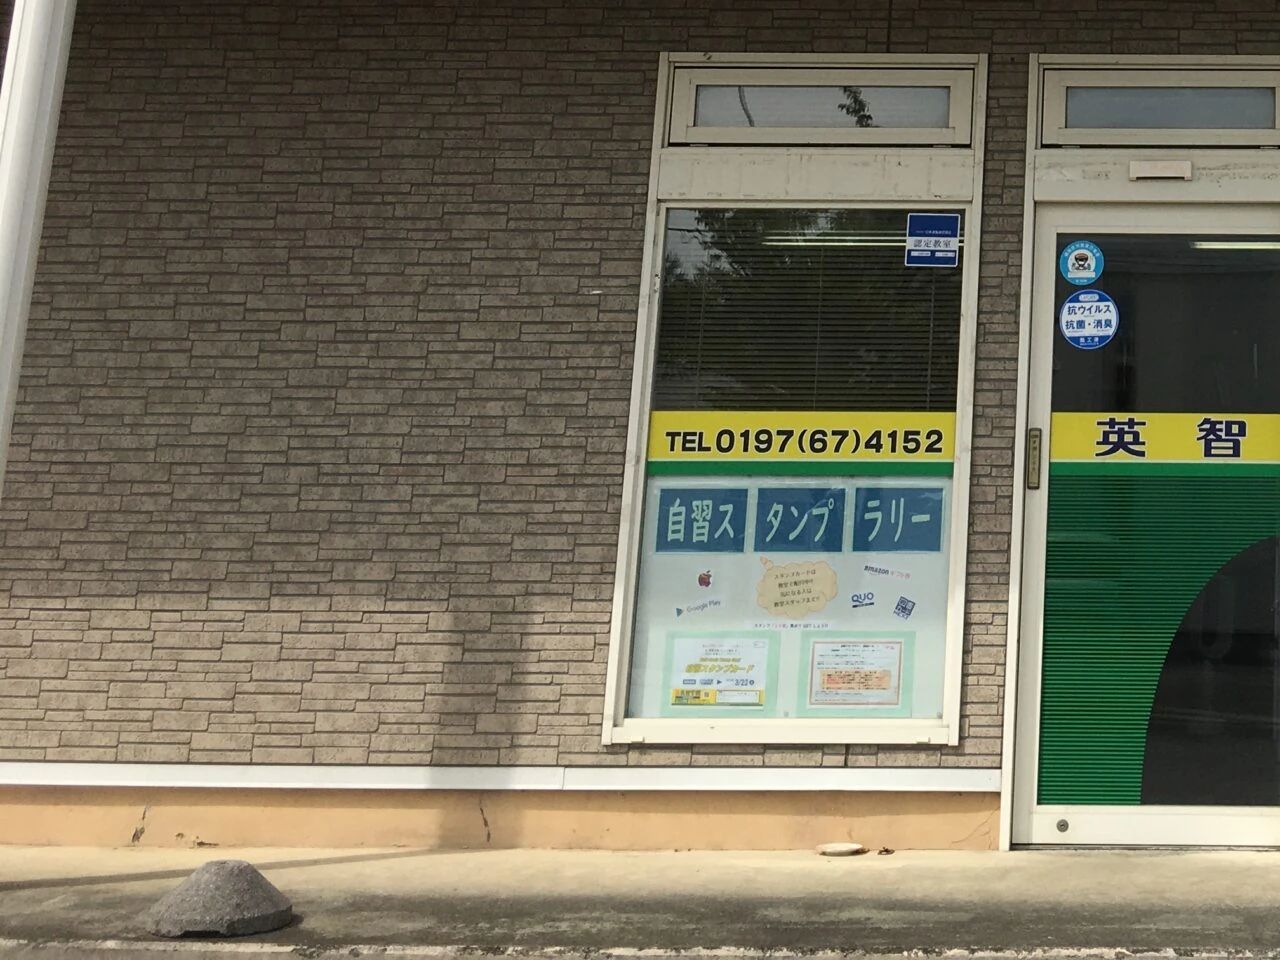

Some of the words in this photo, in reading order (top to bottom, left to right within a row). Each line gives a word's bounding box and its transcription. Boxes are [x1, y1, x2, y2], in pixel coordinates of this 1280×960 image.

[1067, 304, 1112, 316] 抗ウイルス
[1065, 318, 1113, 330] 抗菌・消臭
[863, 565, 890, 576] amazon
[851, 592, 874, 604] QUO
